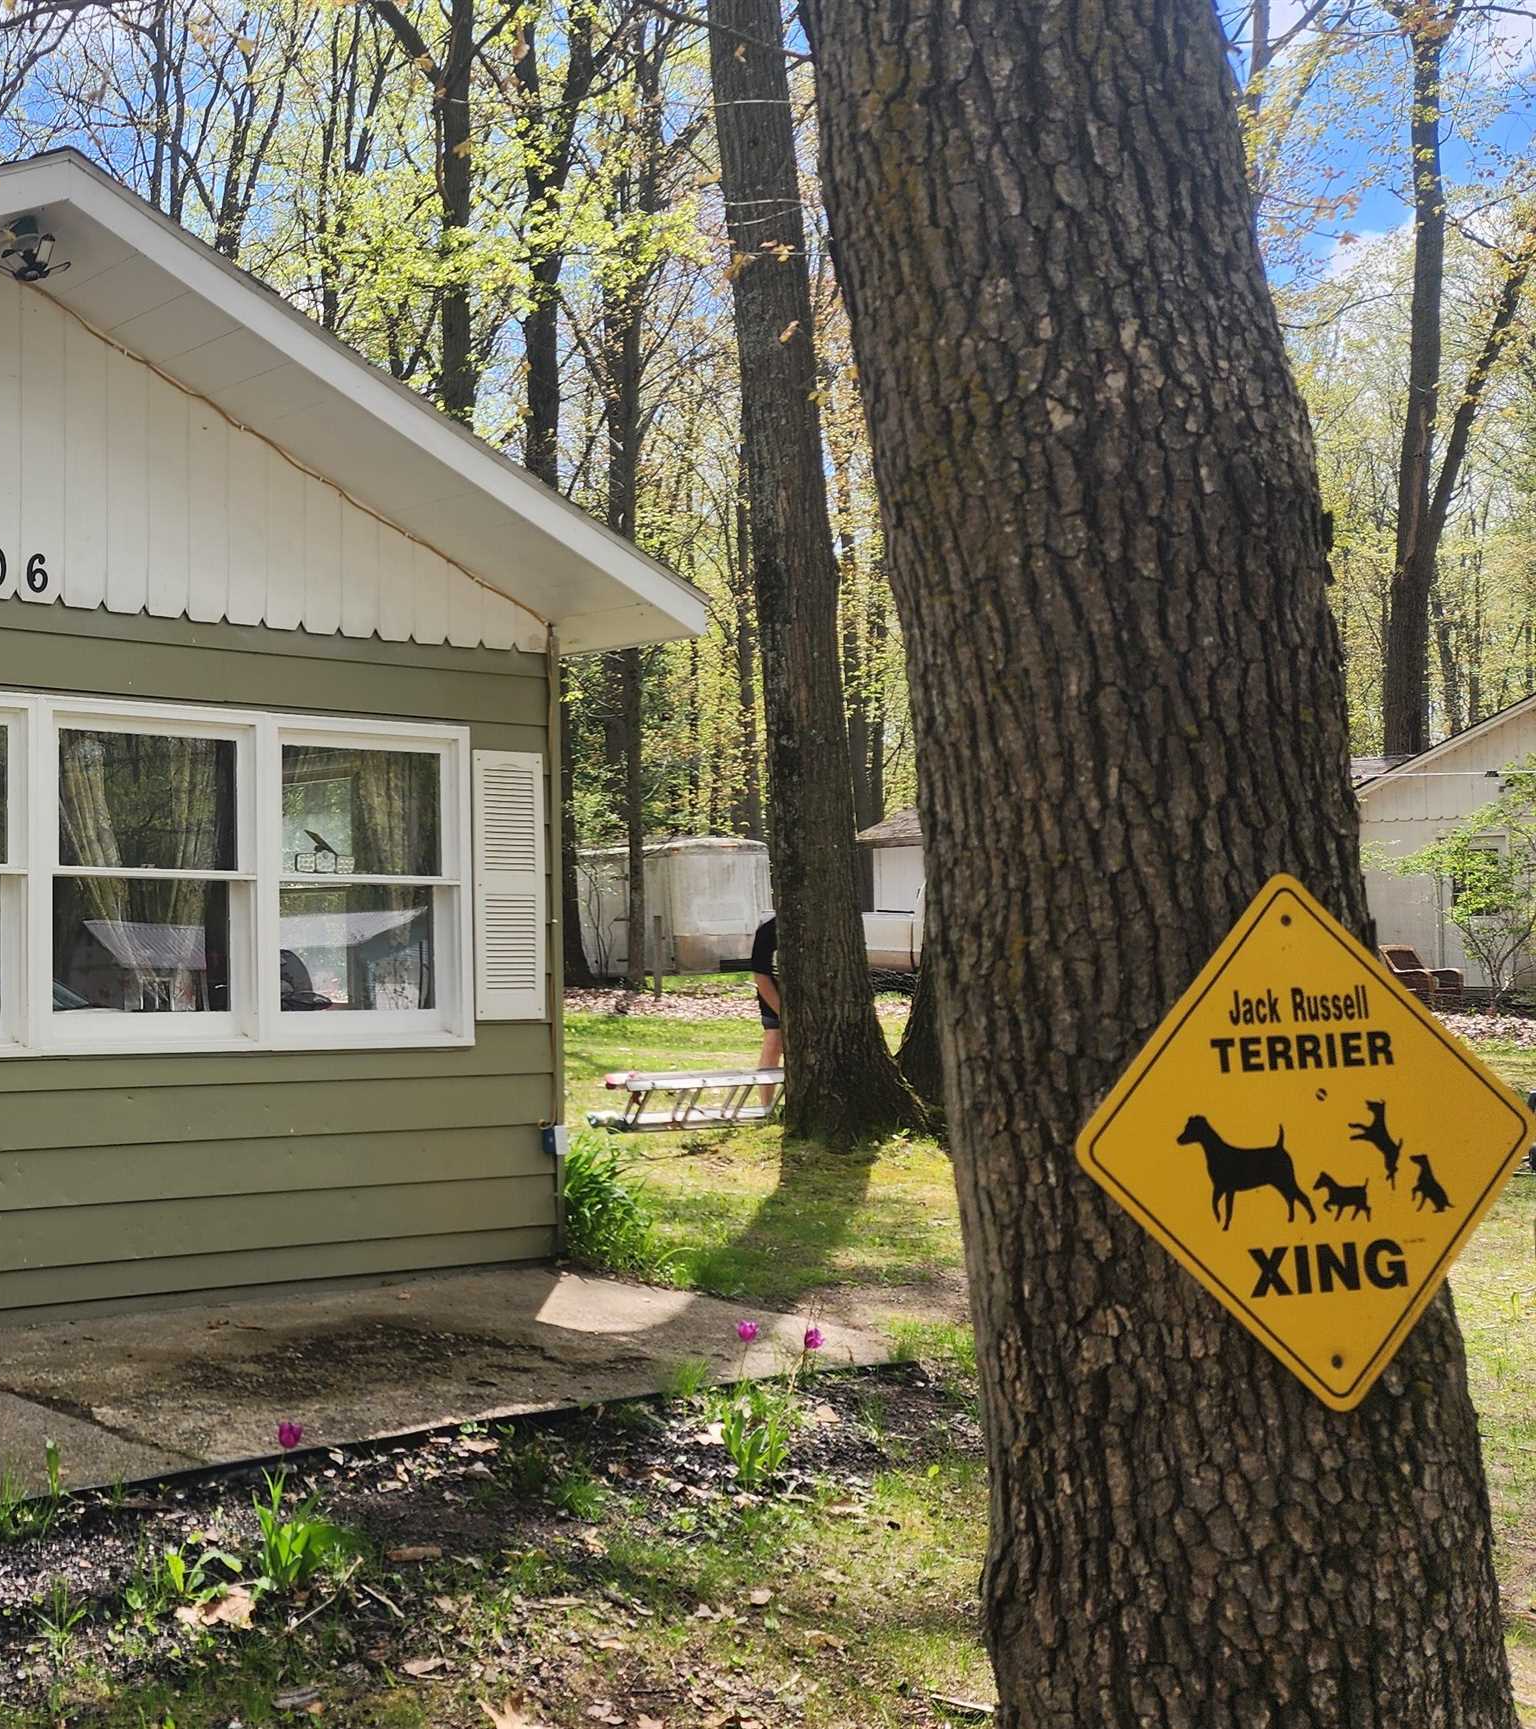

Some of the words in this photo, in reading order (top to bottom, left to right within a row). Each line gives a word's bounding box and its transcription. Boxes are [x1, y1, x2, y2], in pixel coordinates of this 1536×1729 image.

[1228, 988, 1281, 1027] Jack
[1292, 984, 1370, 1023] Russell
[1210, 1031, 1395, 1074] TERRIER
[1247, 1238, 1410, 1299] XING
